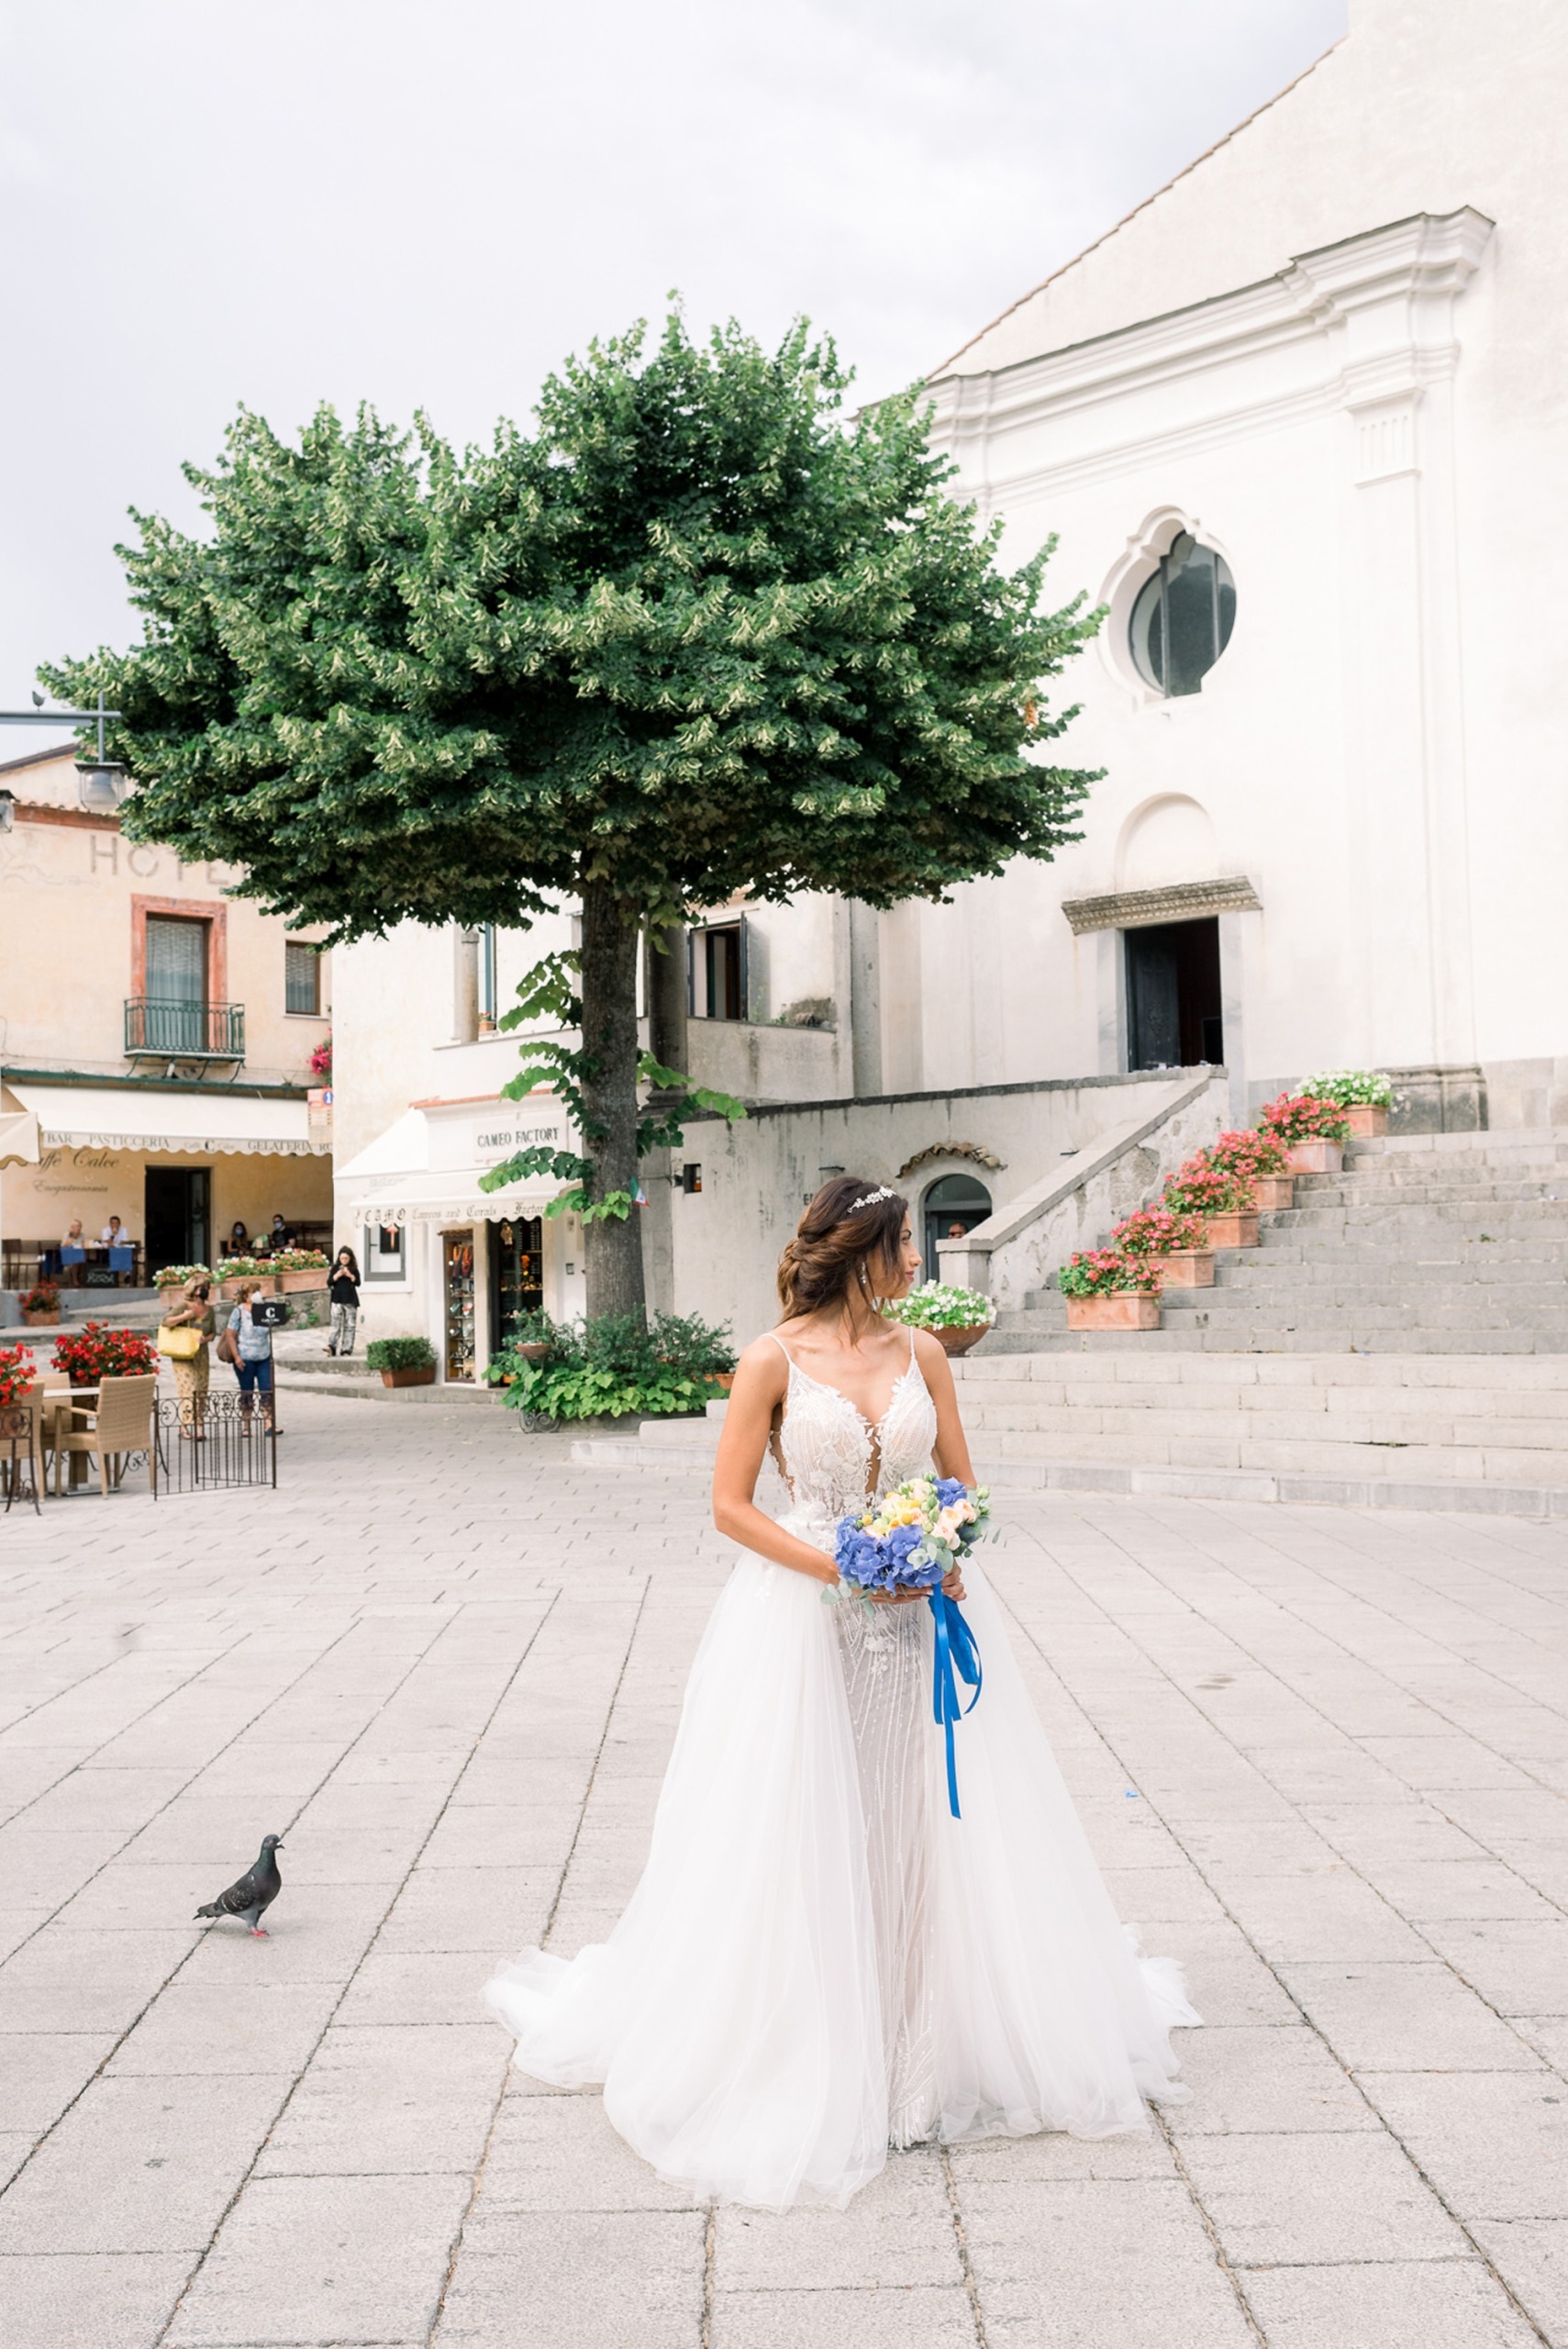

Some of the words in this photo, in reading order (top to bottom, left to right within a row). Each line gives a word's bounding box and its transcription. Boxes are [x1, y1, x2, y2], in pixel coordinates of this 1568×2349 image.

[47, 1132, 73, 1144] BAR
[89, 1134, 171, 1148] PASTICCERIA
[205, 1139, 216, 1152] C
[247, 1140, 313, 1152] GELATERIA
[477, 1131, 512, 1148] CAMEO
[516, 1127, 559, 1144] FACTORY
[514, 1201, 545, 1215] Factor
[265, 1307, 275, 1319] C
